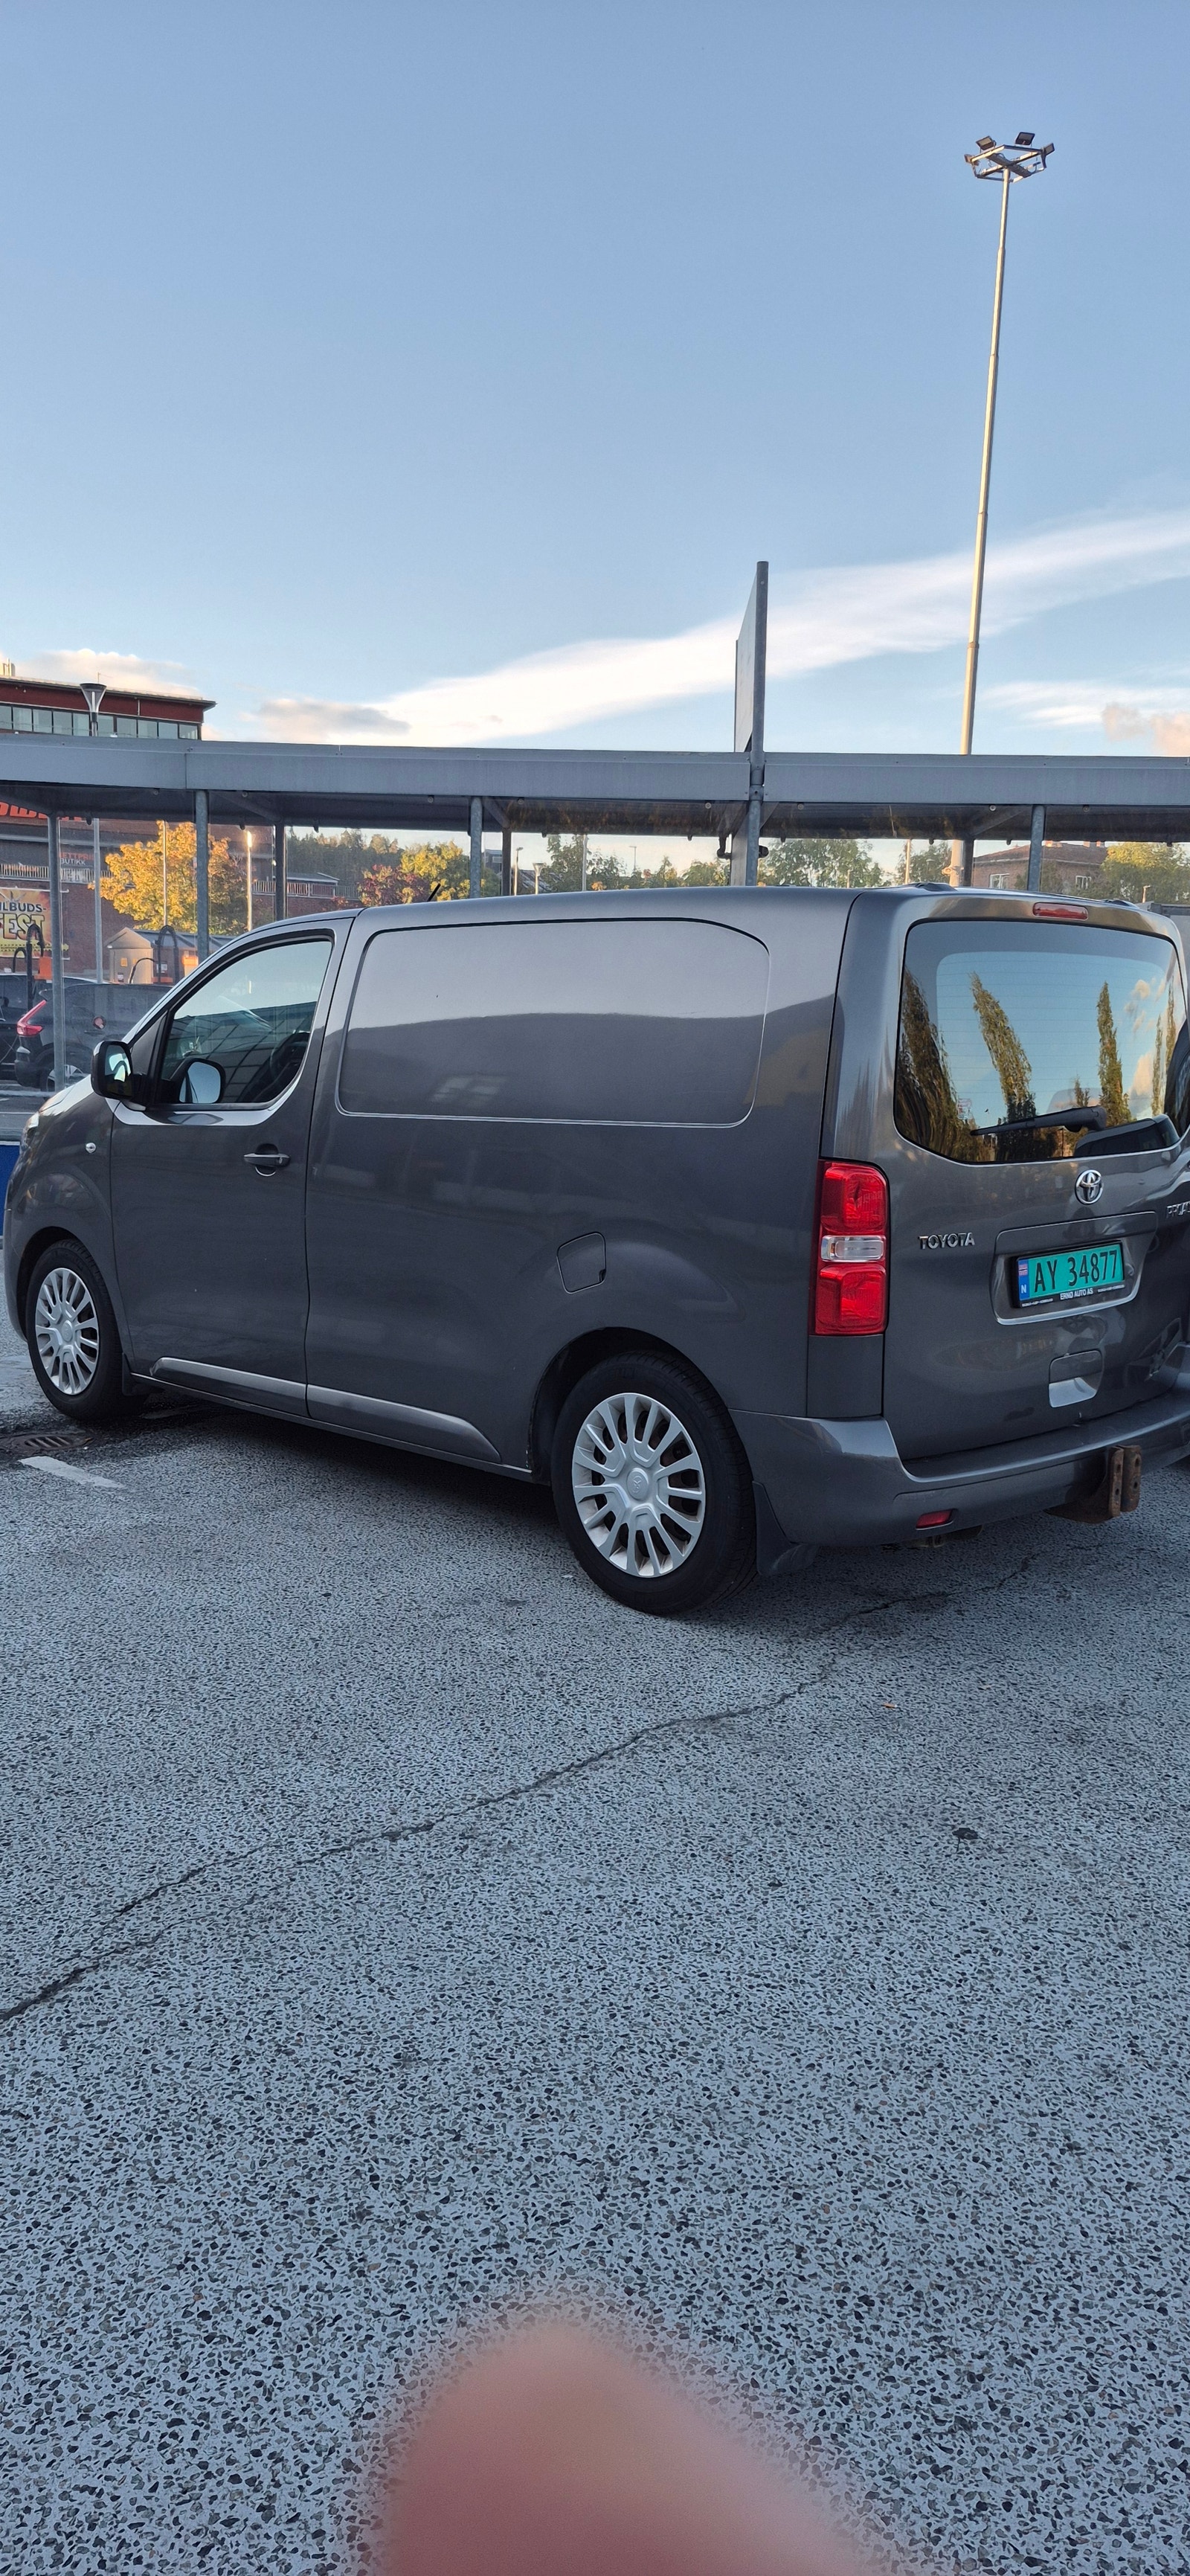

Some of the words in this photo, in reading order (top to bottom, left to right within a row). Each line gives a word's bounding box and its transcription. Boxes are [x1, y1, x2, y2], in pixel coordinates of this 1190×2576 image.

[919, 1232, 975, 1250] TOYOTA
[1034, 1259, 1058, 1293] AY
[1067, 1250, 1117, 1287] 34877
[1020, 1284, 1027, 1294] N
[1074, 1288, 1087, 1298] AUTO
[1087, 1288, 1094, 1296] AS
